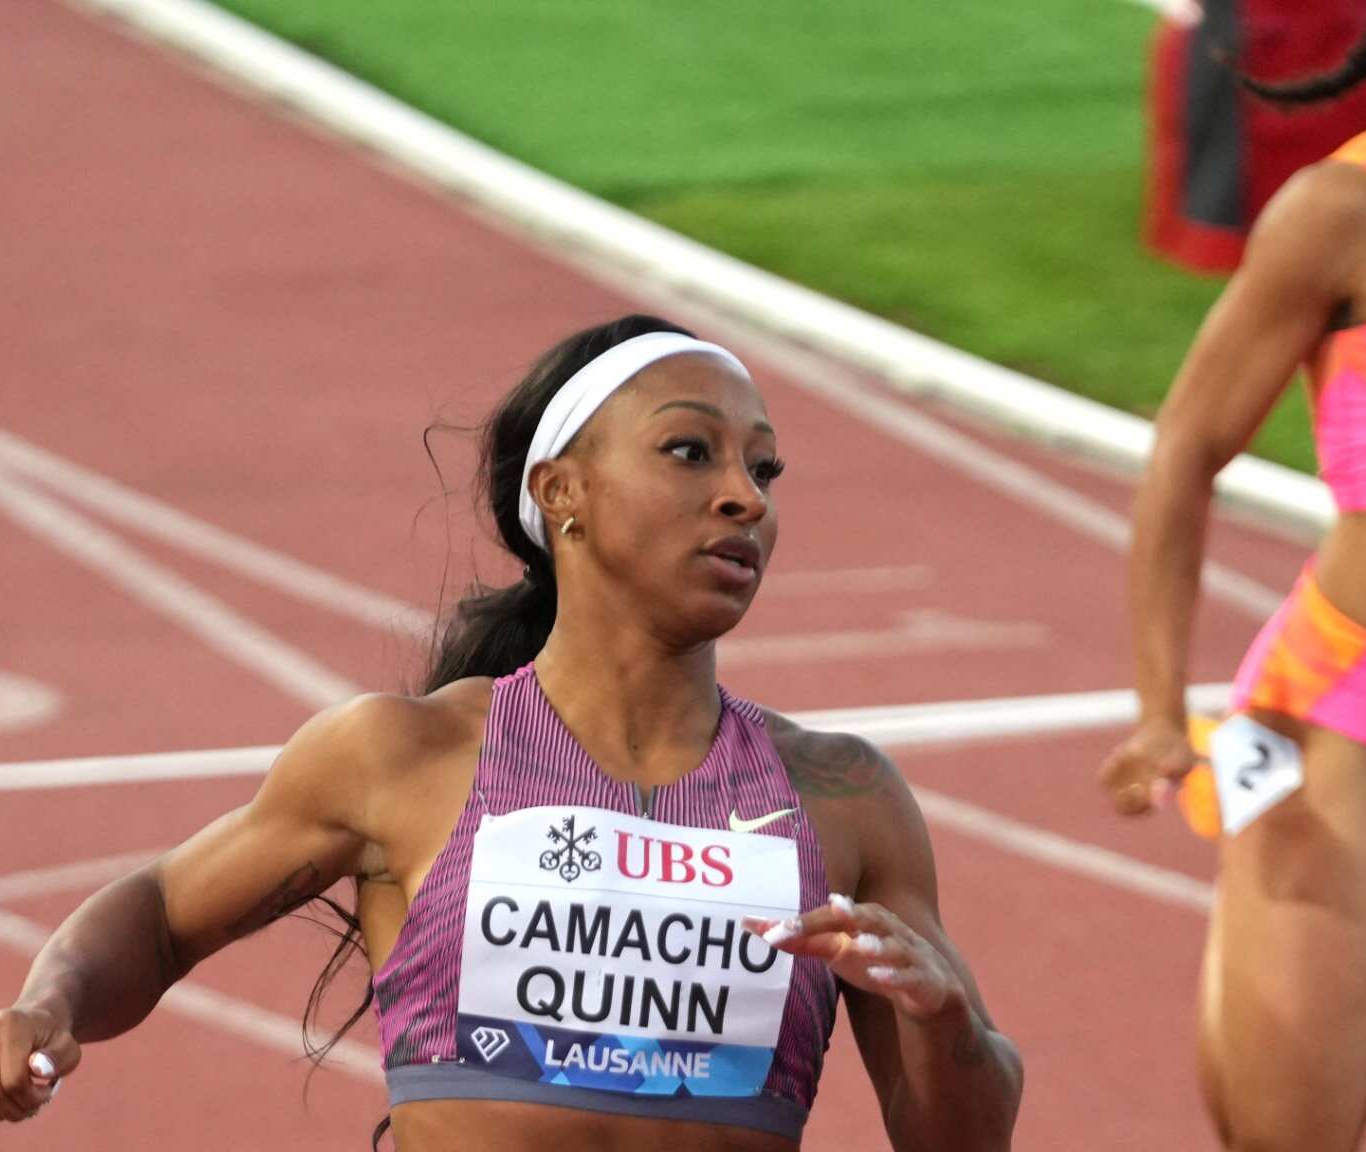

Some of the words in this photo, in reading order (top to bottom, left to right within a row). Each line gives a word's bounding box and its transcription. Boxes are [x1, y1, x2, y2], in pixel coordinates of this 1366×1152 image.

[1237, 742, 1271, 791] 2
[614, 829, 734, 888] UBS
[481, 896, 778, 974] CAMACHO
[516, 966, 729, 1035] QUINN
[545, 1039, 712, 1079] LAUSANNE
